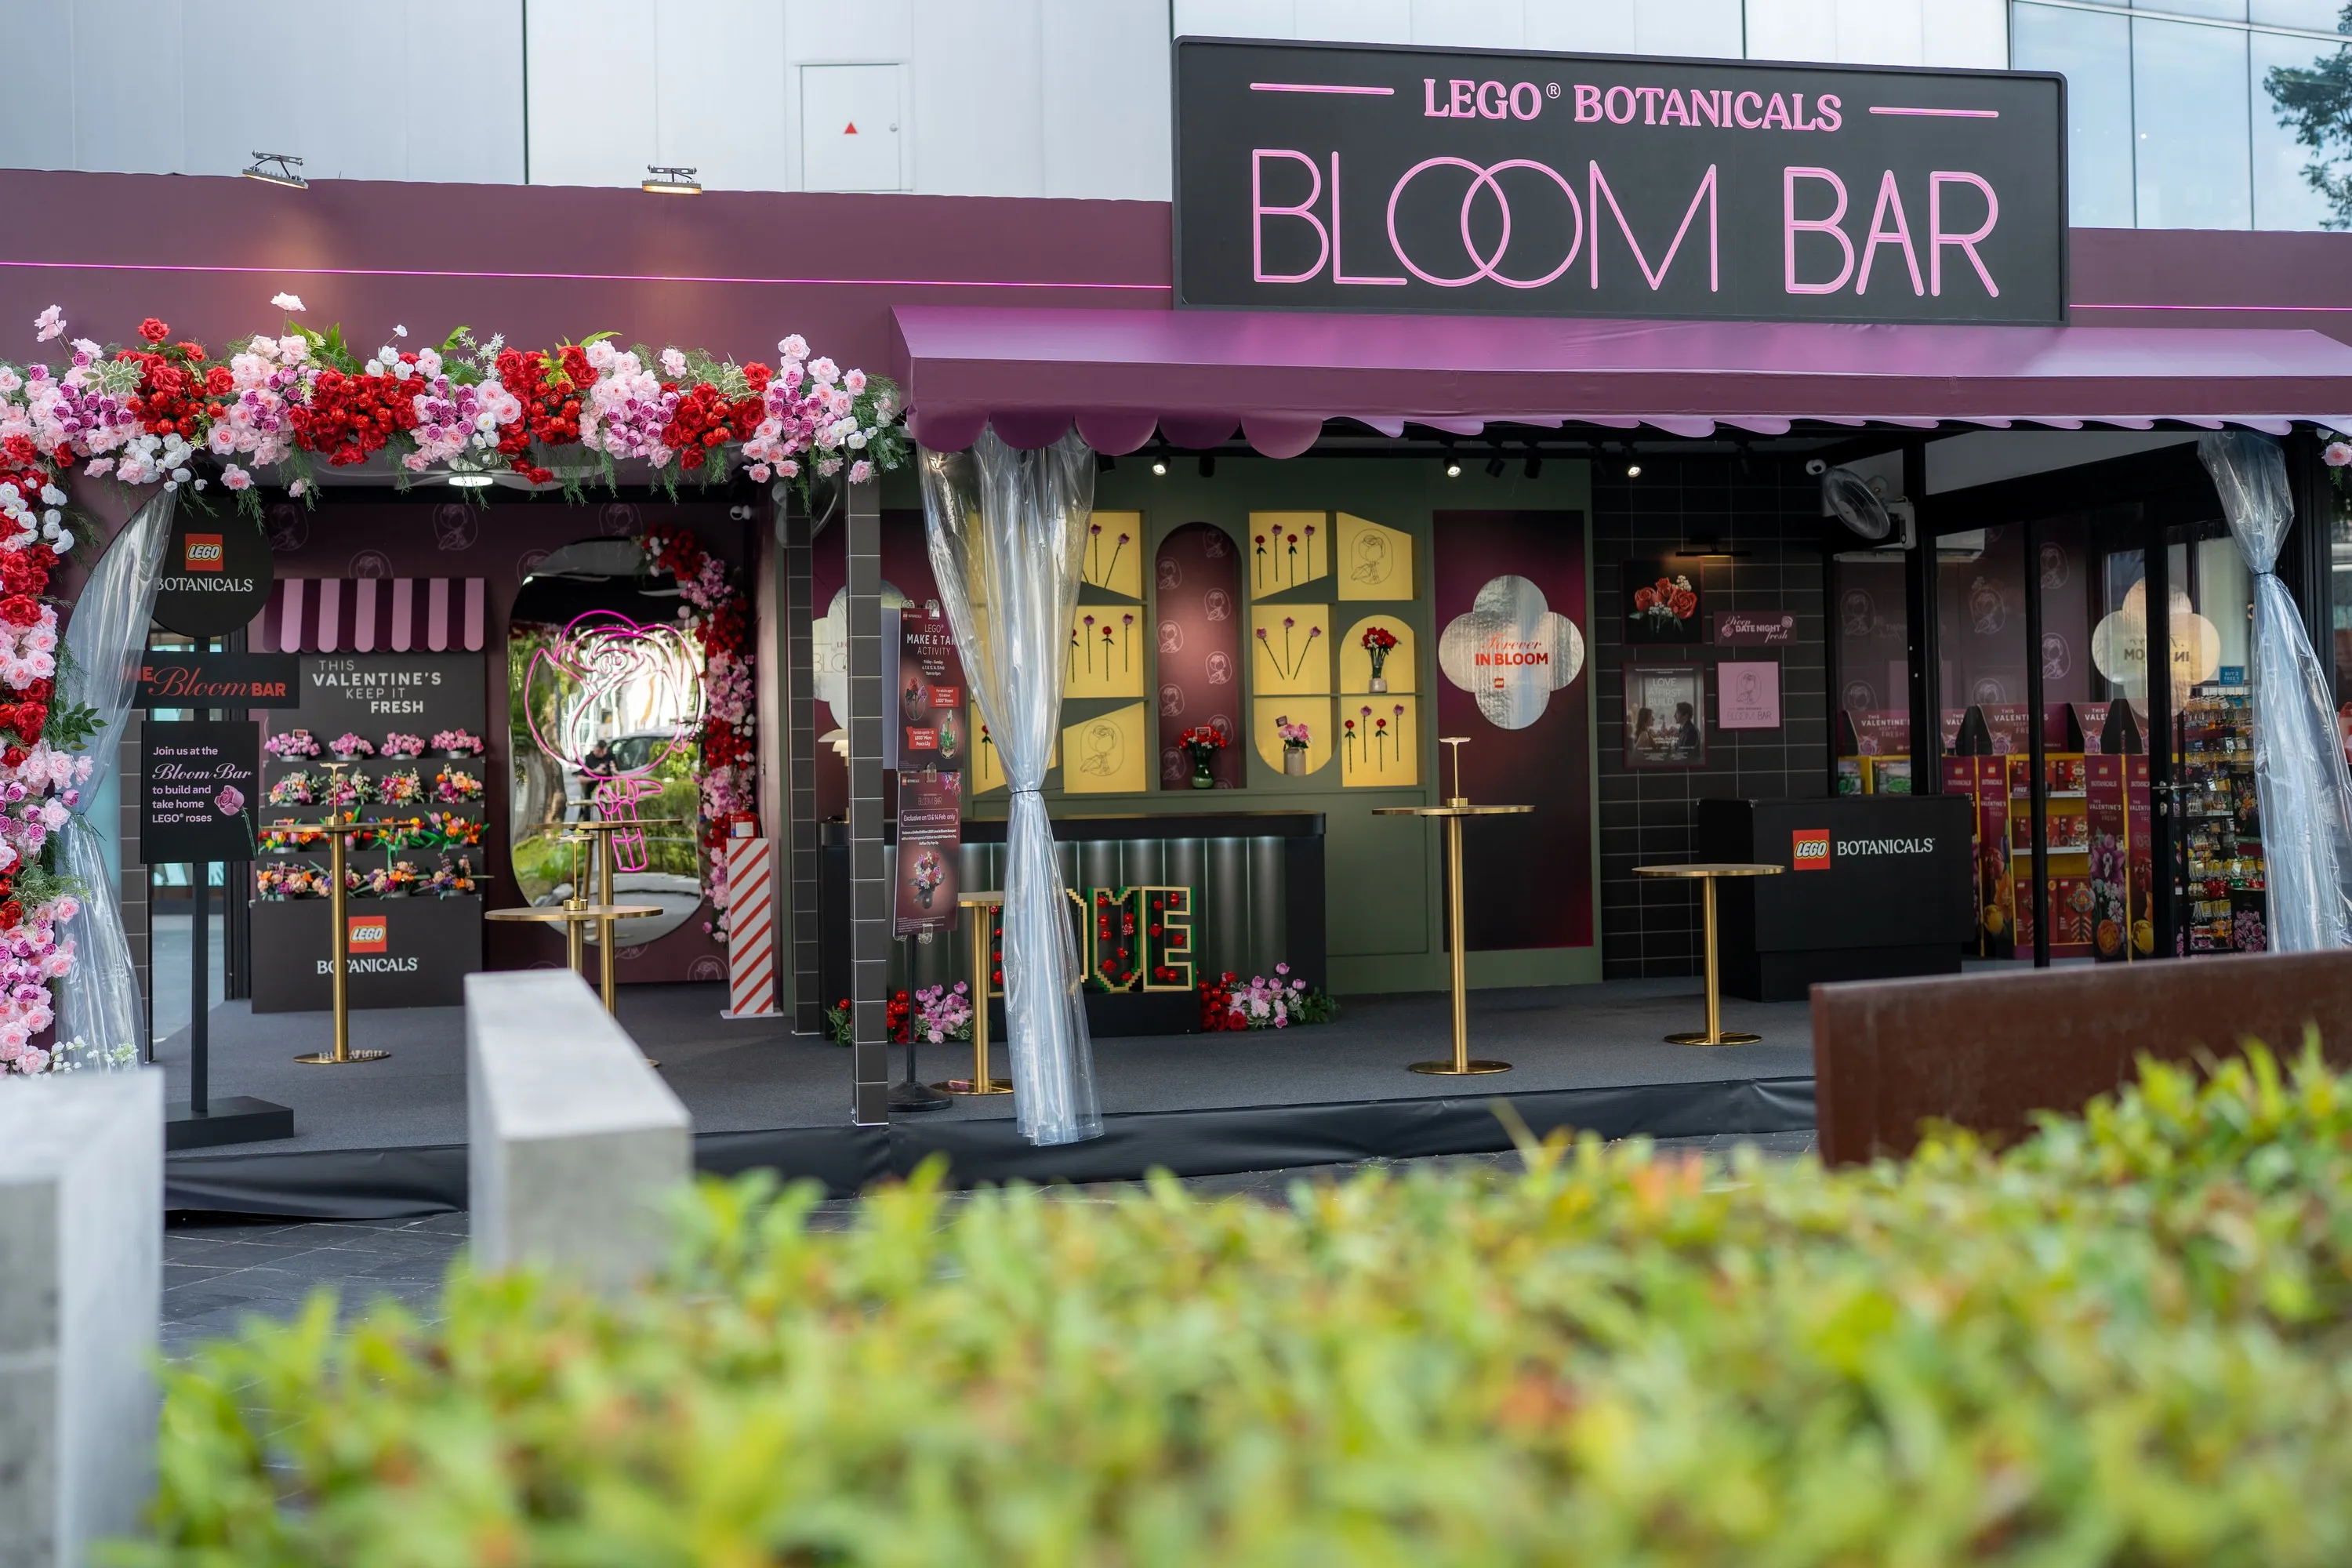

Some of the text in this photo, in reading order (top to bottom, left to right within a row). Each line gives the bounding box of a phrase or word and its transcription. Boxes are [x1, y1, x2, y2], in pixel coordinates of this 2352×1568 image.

[1573, 84, 1842, 132] BOTANICALS
[1252, 148, 2000, 298] BLOOM BAR
[187, 544, 222, 561] LEGO
[1725, 615, 1751, 626] Keep
[1756, 624, 1781, 633] NIGHT
[906, 633, 930, 644] MAKE
[932, 635, 938, 645] &
[1482, 633, 1541, 649] Forever
[1764, 630, 1788, 644] fresh
[917, 646, 951, 656] ACTIVITY
[318, 659, 355, 671] THIS
[1475, 652, 1548, 666] IN BLOOM
[147, 666, 252, 697] Bloom
[251, 682, 287, 697] BAR
[312, 671, 441, 687] VALENTINE'S
[1653, 677, 1677, 687] LOVE
[346, 688, 405, 699] KEEP IT
[1659, 688, 1682, 697] FIRST
[370, 700, 423, 713] FRESH
[1648, 697, 1675, 706] BUILD
[1726, 710, 1772, 721] BLOOM BAR
[152, 746, 174, 755] Join
[201, 746, 219, 755] the
[151, 762, 252, 780] Bloom Bar
[165, 785, 191, 794] build
[192, 785, 212, 794] and
[152, 799, 205, 808] take home
[934, 797, 942, 805] BAR
[1795, 838, 1934, 859] LEGO BOTANICALS
[350, 925, 387, 943] LEGO
